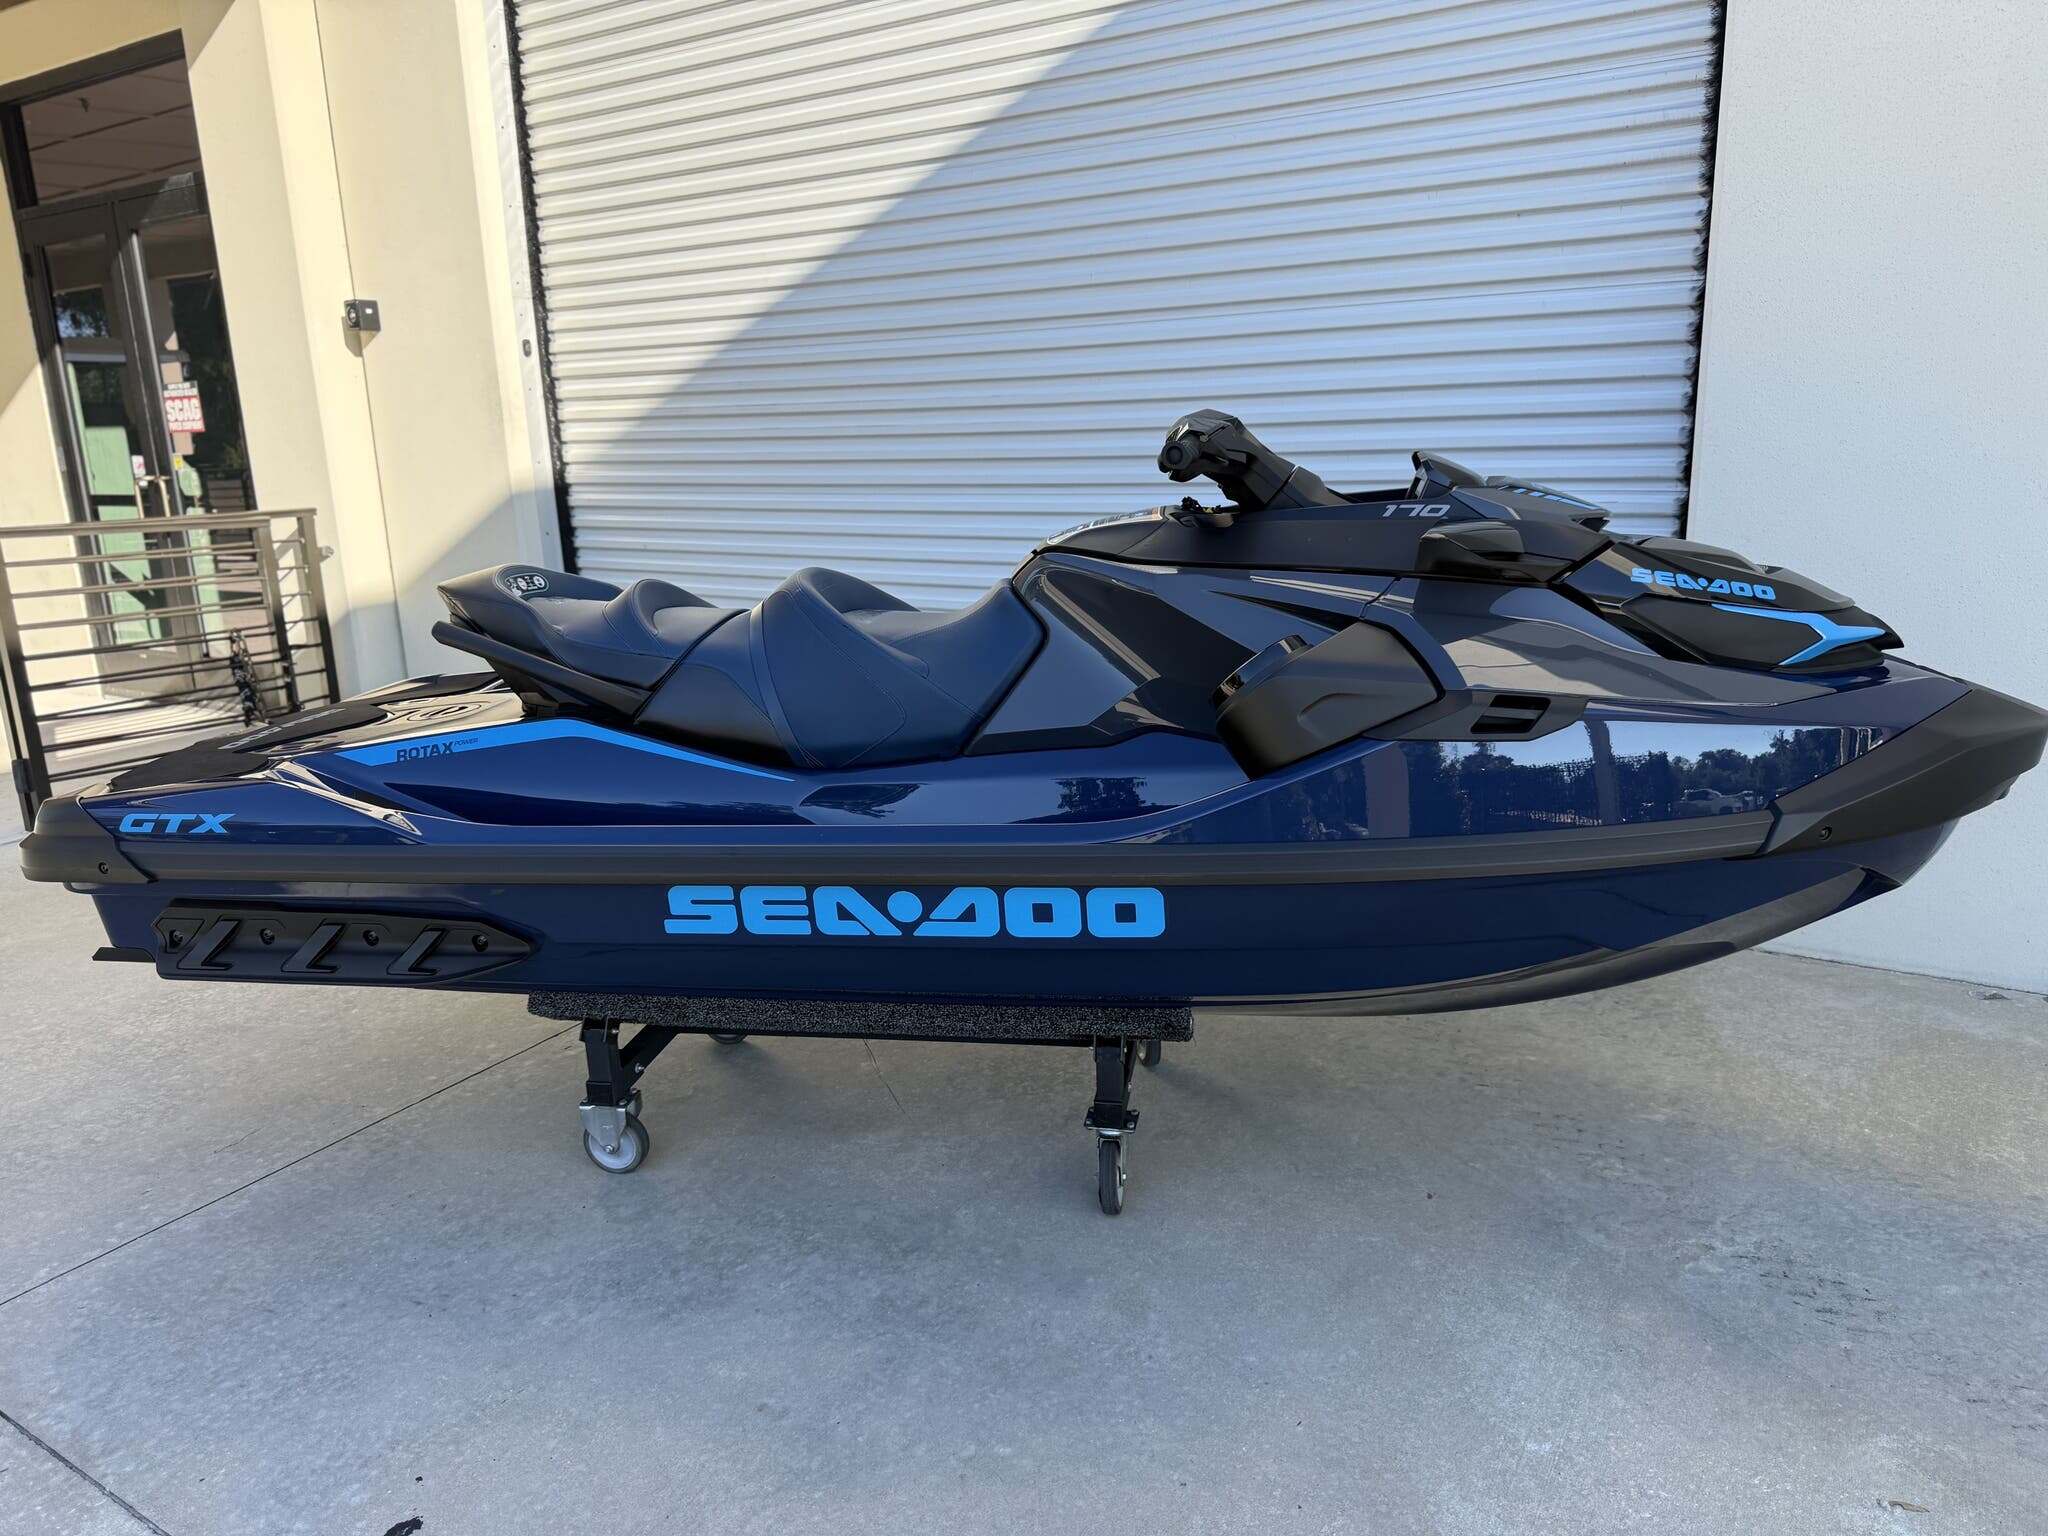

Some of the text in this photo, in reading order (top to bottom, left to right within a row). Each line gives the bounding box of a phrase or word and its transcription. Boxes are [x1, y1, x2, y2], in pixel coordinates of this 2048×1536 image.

[1382, 504, 1451, 517] 170
[396, 737, 480, 763] ROTAX POWER
[119, 813, 237, 834] GTX
